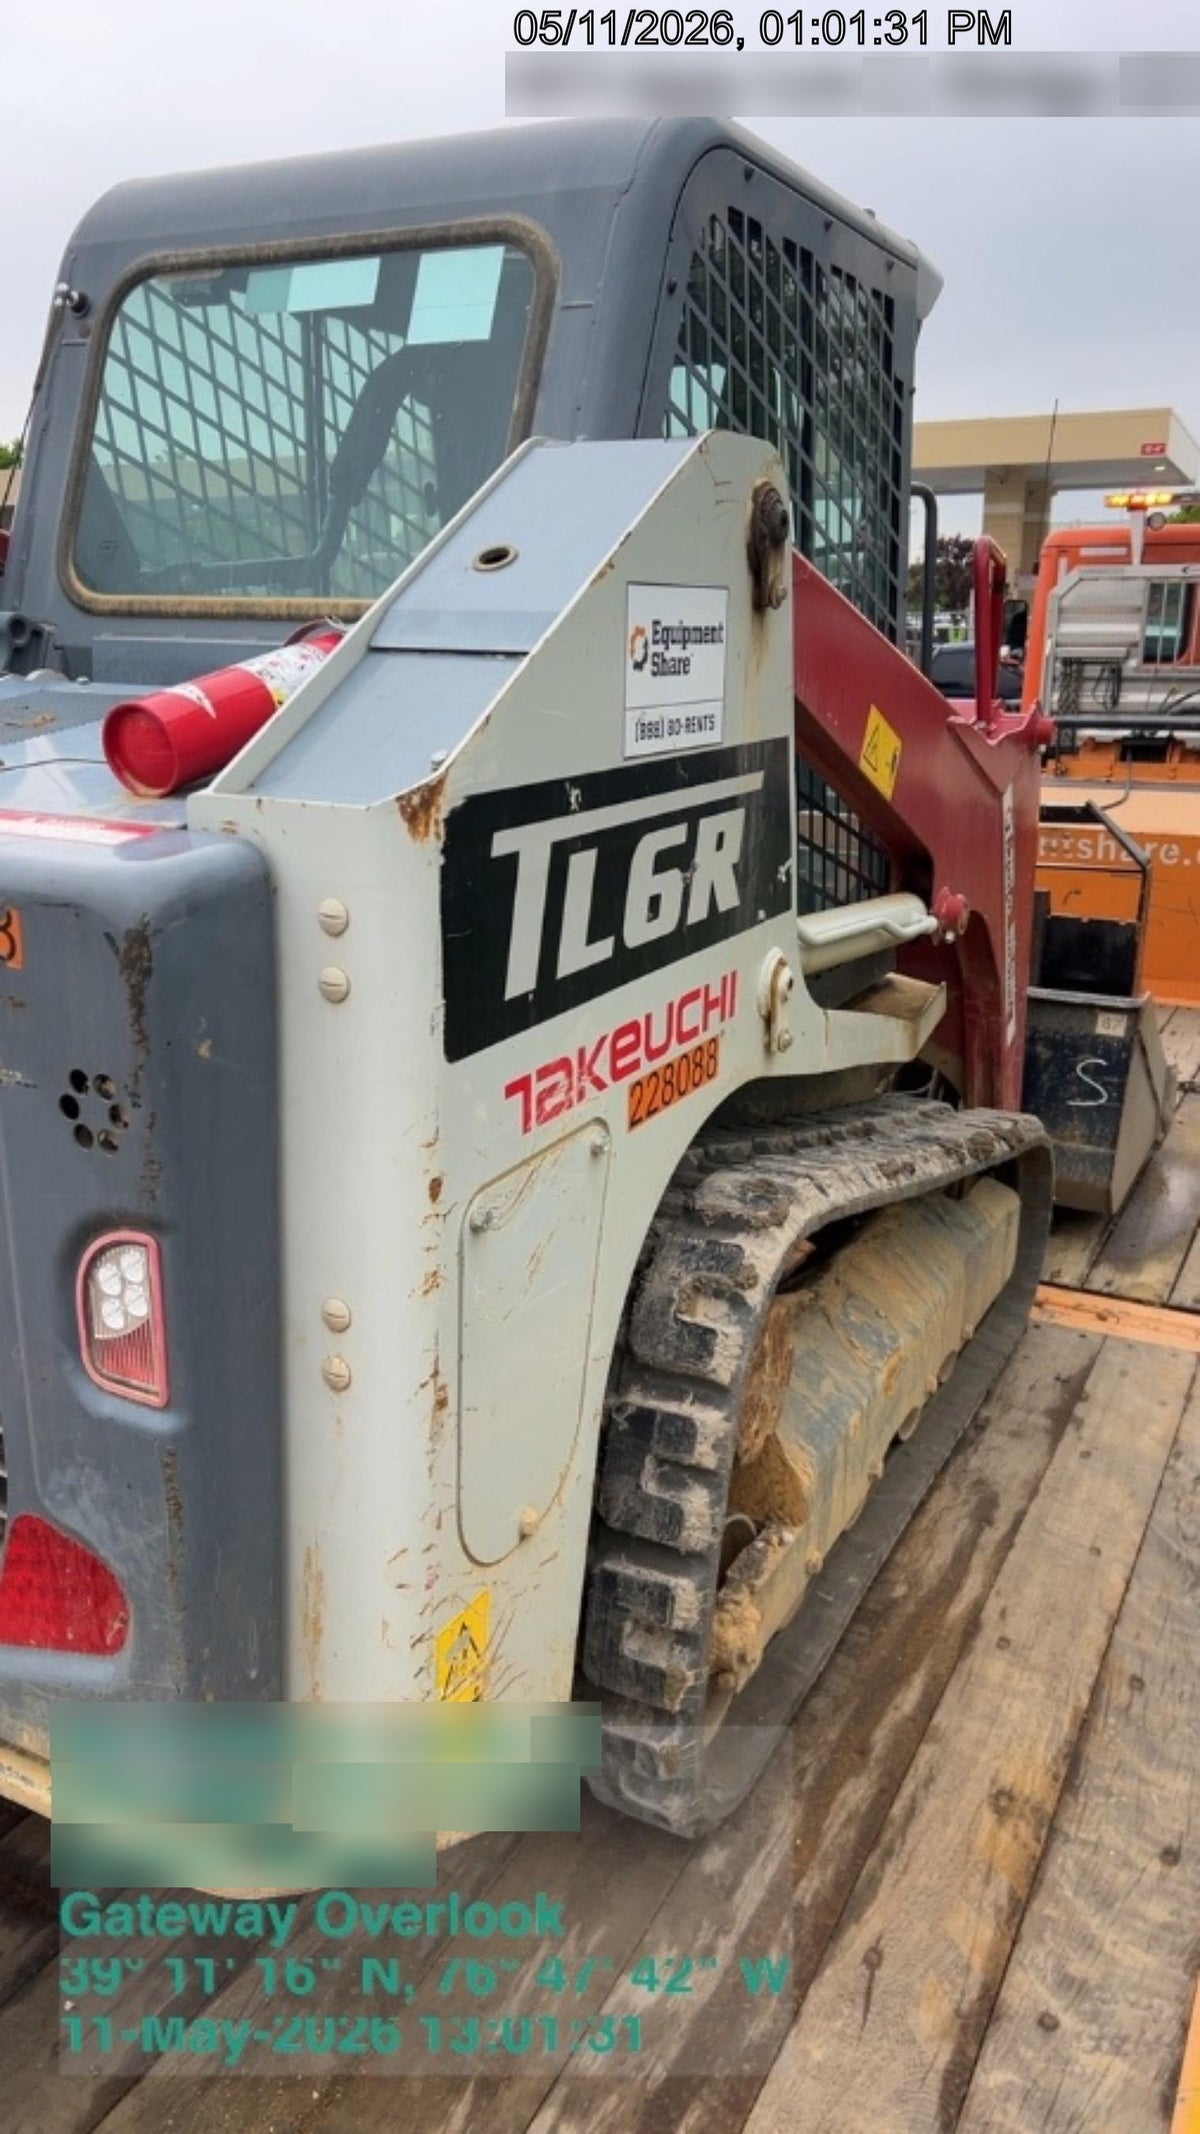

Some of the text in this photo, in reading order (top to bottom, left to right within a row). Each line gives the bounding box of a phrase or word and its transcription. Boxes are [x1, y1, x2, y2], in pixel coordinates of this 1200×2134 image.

[651, 620, 724, 651] Equipment
[651, 651, 691, 677] Share
[490, 770, 765, 1002] TL6R
[629, 1037, 719, 1129] 228088
